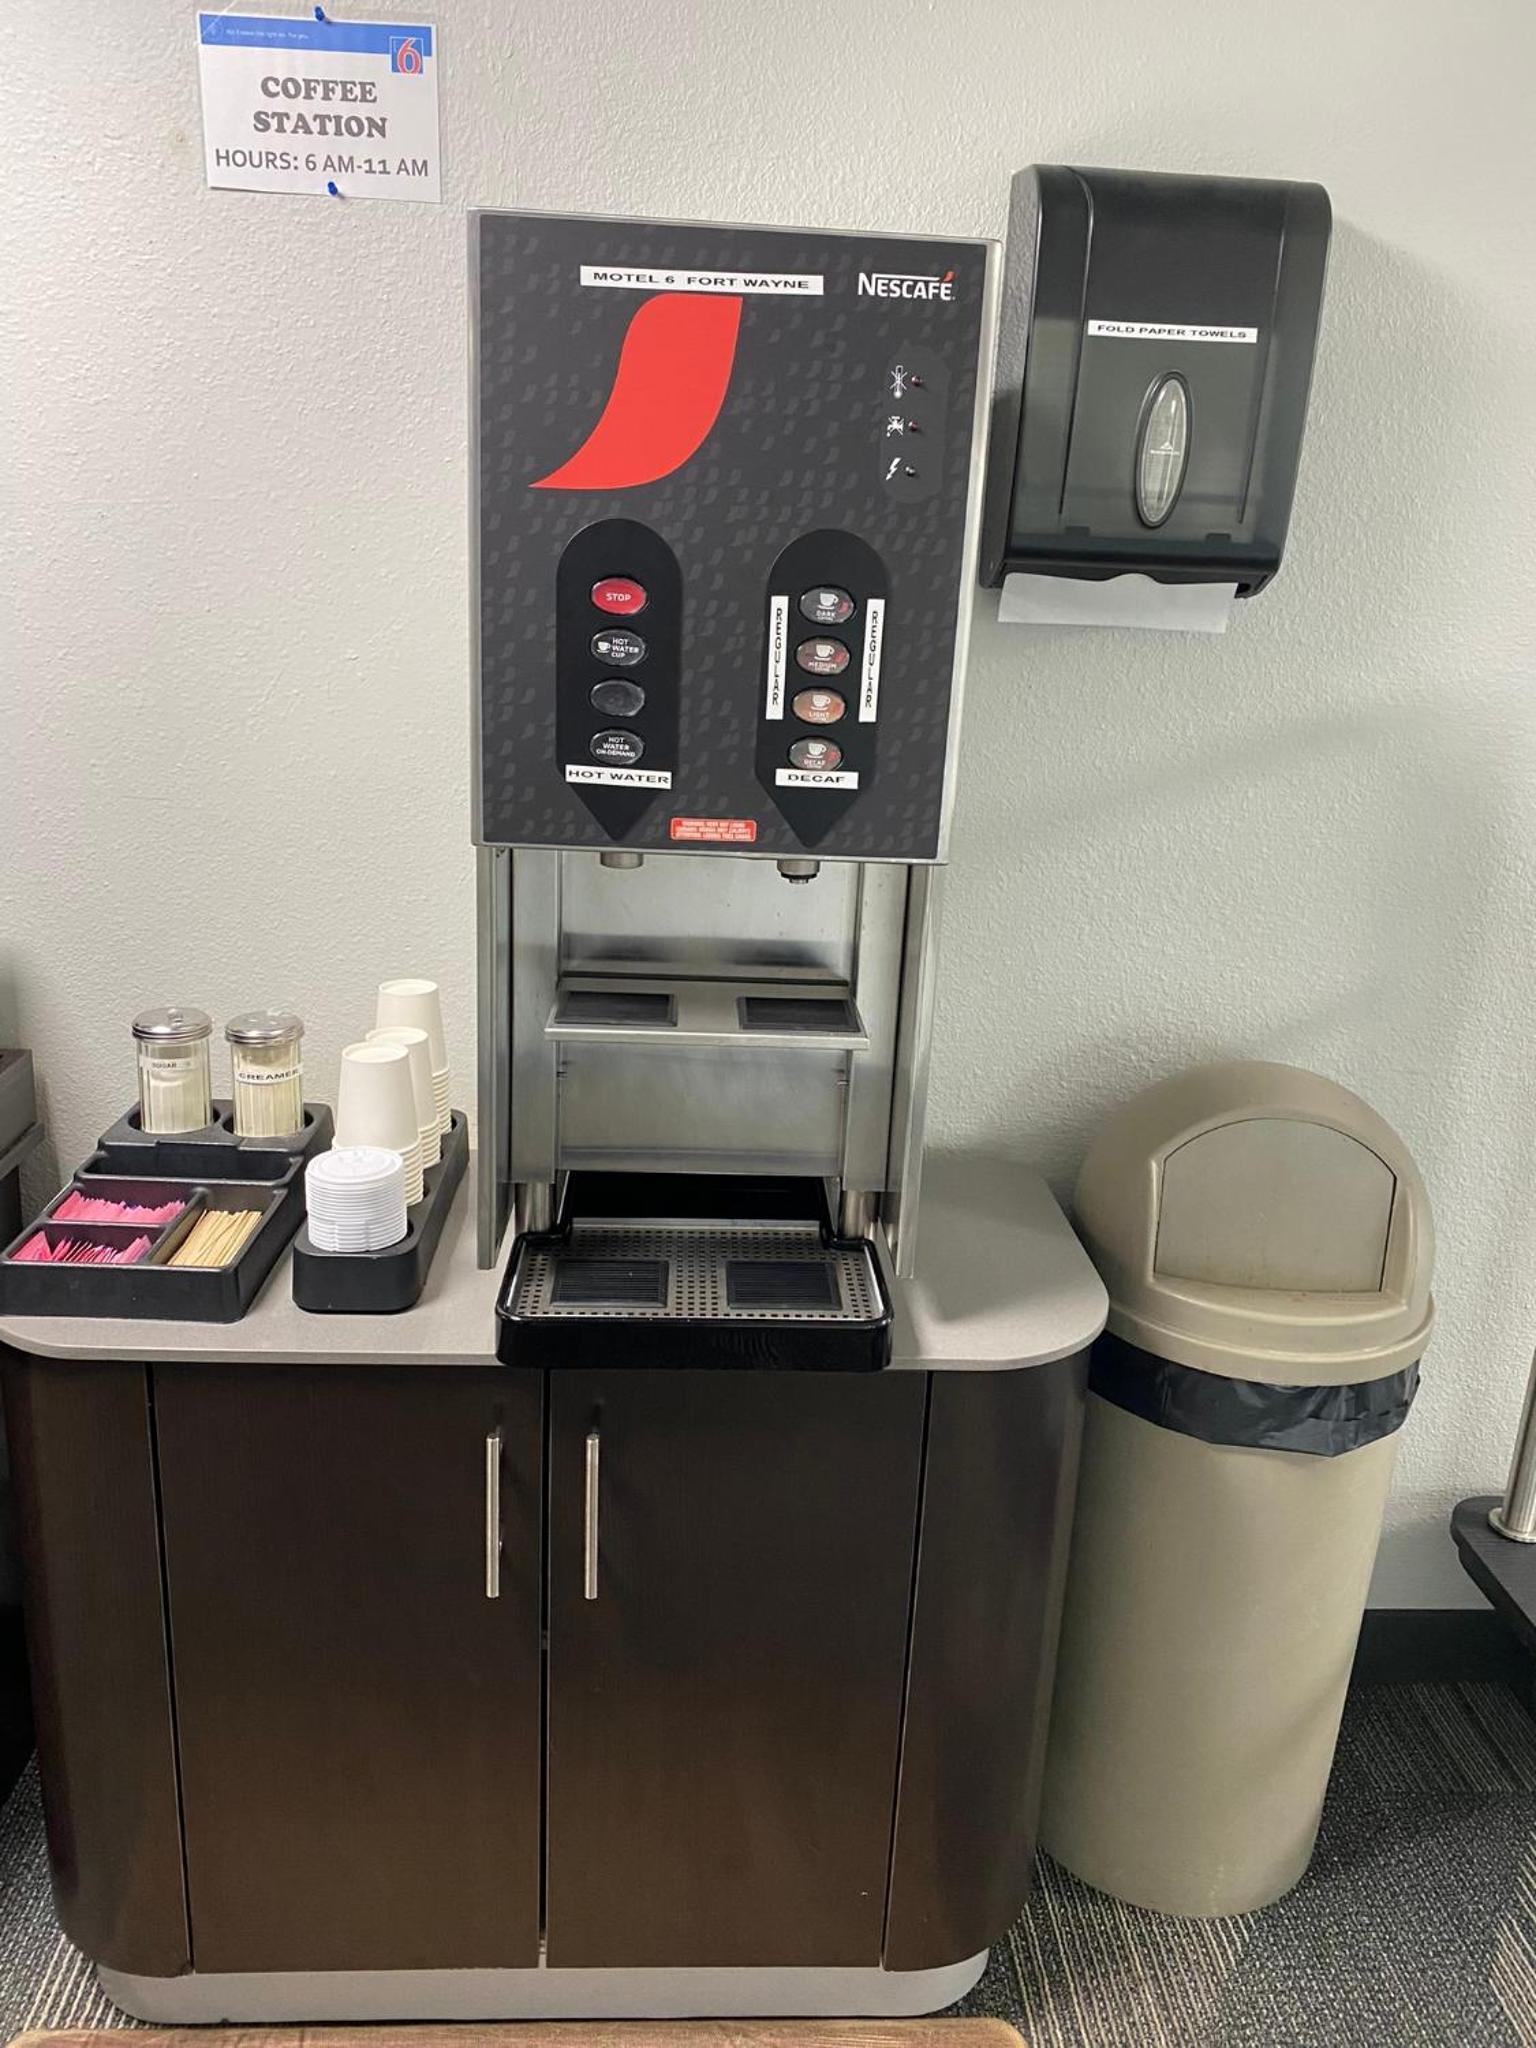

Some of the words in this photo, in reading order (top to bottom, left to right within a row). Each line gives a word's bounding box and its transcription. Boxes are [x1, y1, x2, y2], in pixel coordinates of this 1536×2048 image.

[397, 37, 423, 74] 6
[261, 76, 377, 103] COFFEE
[253, 111, 387, 138] STATION
[215, 149, 299, 171] HOURS:
[305, 153, 317, 172] 6
[323, 155, 391, 175] AM-11
[396, 158, 429, 177] AM
[593, 272, 659, 283] MOTEL
[664, 274, 675, 285] 6
[687, 276, 737, 287] FORT
[743, 278, 810, 289] WAYNE
[1097, 324, 1135, 334] FOLD
[1139, 327, 1186, 336] PAPER
[1191, 329, 1247, 339] TOWELS
[605, 593, 631, 602] STOP
[612, 637, 629, 645] HOT
[611, 645, 639, 654] WATER
[772, 608, 783, 706] REGULAR
[865, 611, 878, 708] REGULAR
[602, 742, 630, 750] WATER
[608, 736, 625, 744] HOT
[568, 769, 605, 779] HOT
[609, 772, 670, 784] WATER
[788, 774, 845, 784] DECAF
